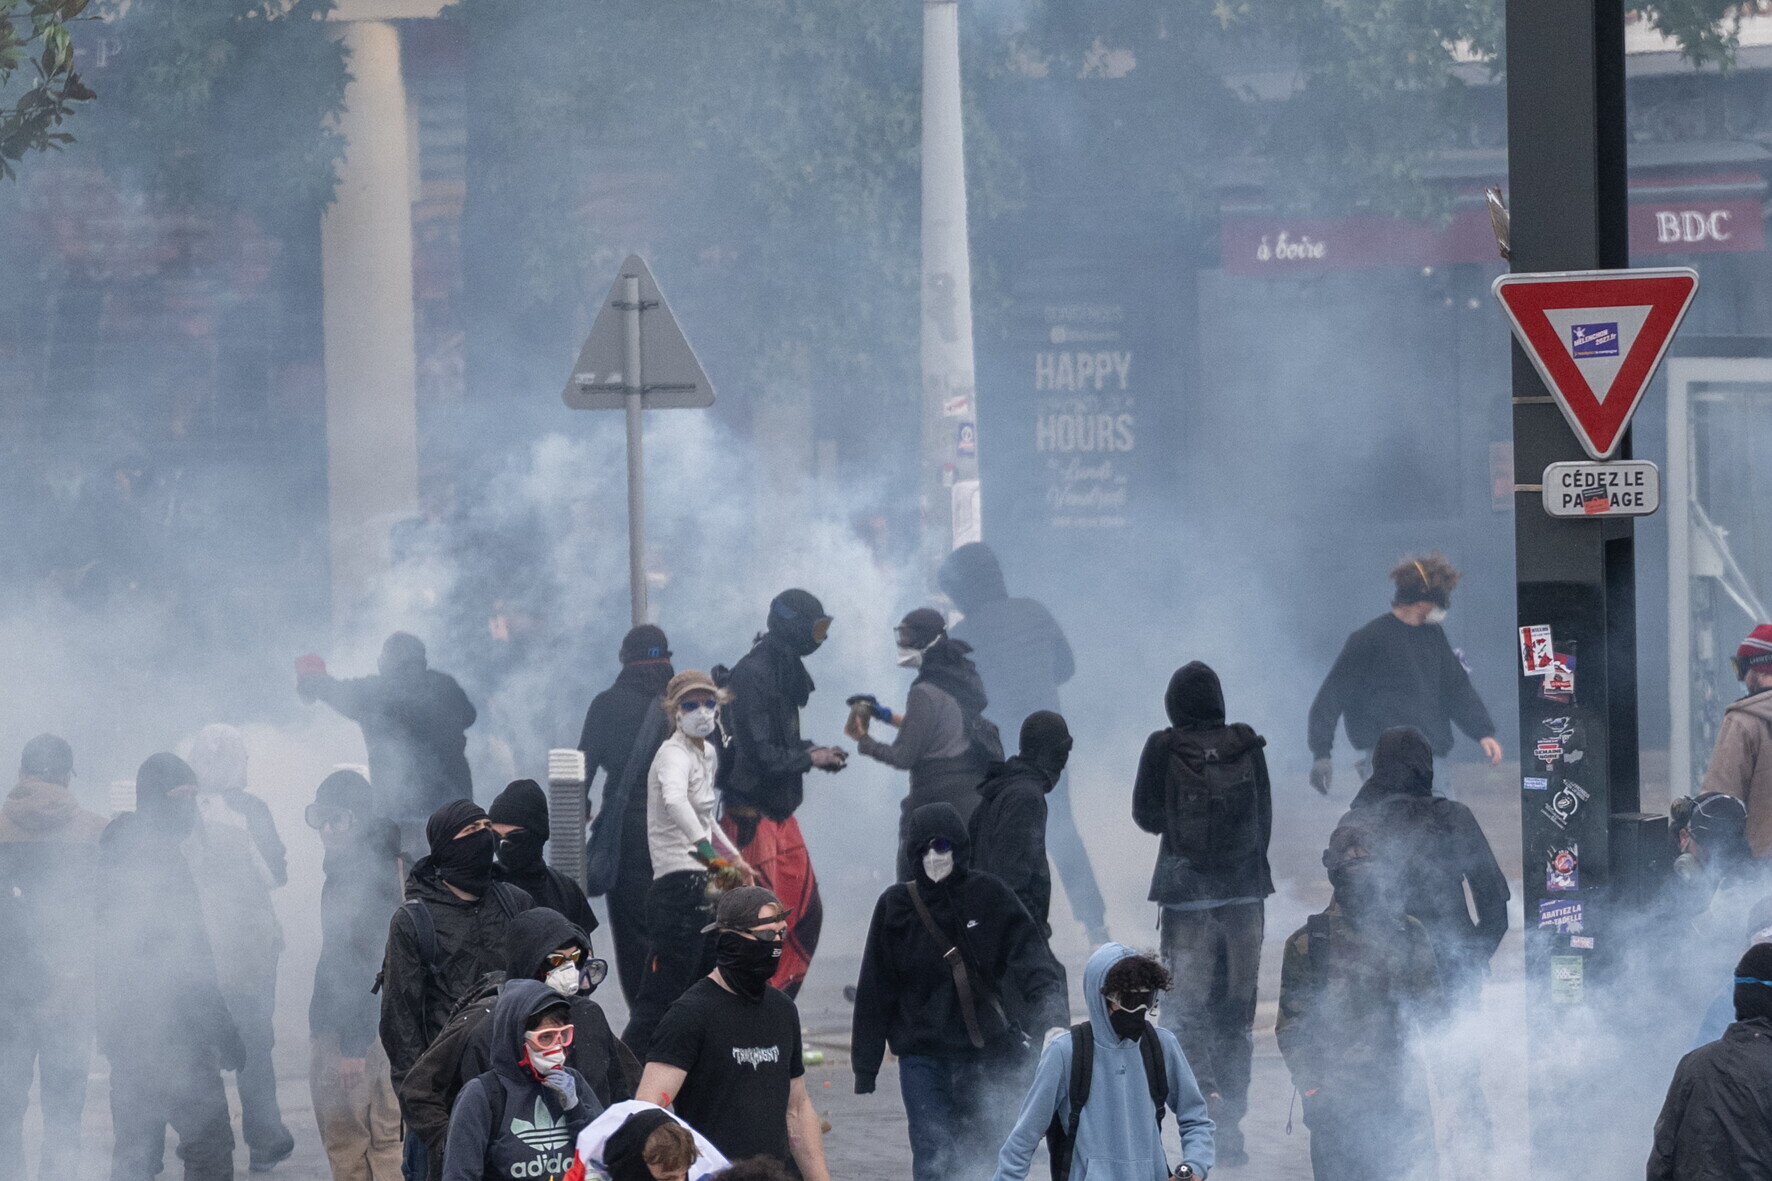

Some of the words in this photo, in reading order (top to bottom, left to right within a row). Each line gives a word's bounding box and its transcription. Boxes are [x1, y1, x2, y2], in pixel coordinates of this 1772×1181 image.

[1655, 210, 1732, 243] BDC
[1276, 230, 1327, 260] boire
[1035, 352, 1132, 391] HAPPY
[1036, 413, 1135, 451] HOURS
[1562, 470, 1619, 488] CÉDEZ
[1624, 471, 1645, 487] LE
[1562, 491, 1645, 508] PAAGE
[1541, 906, 1571, 920] ABATTEZ
[1572, 904, 1581, 913] LA
